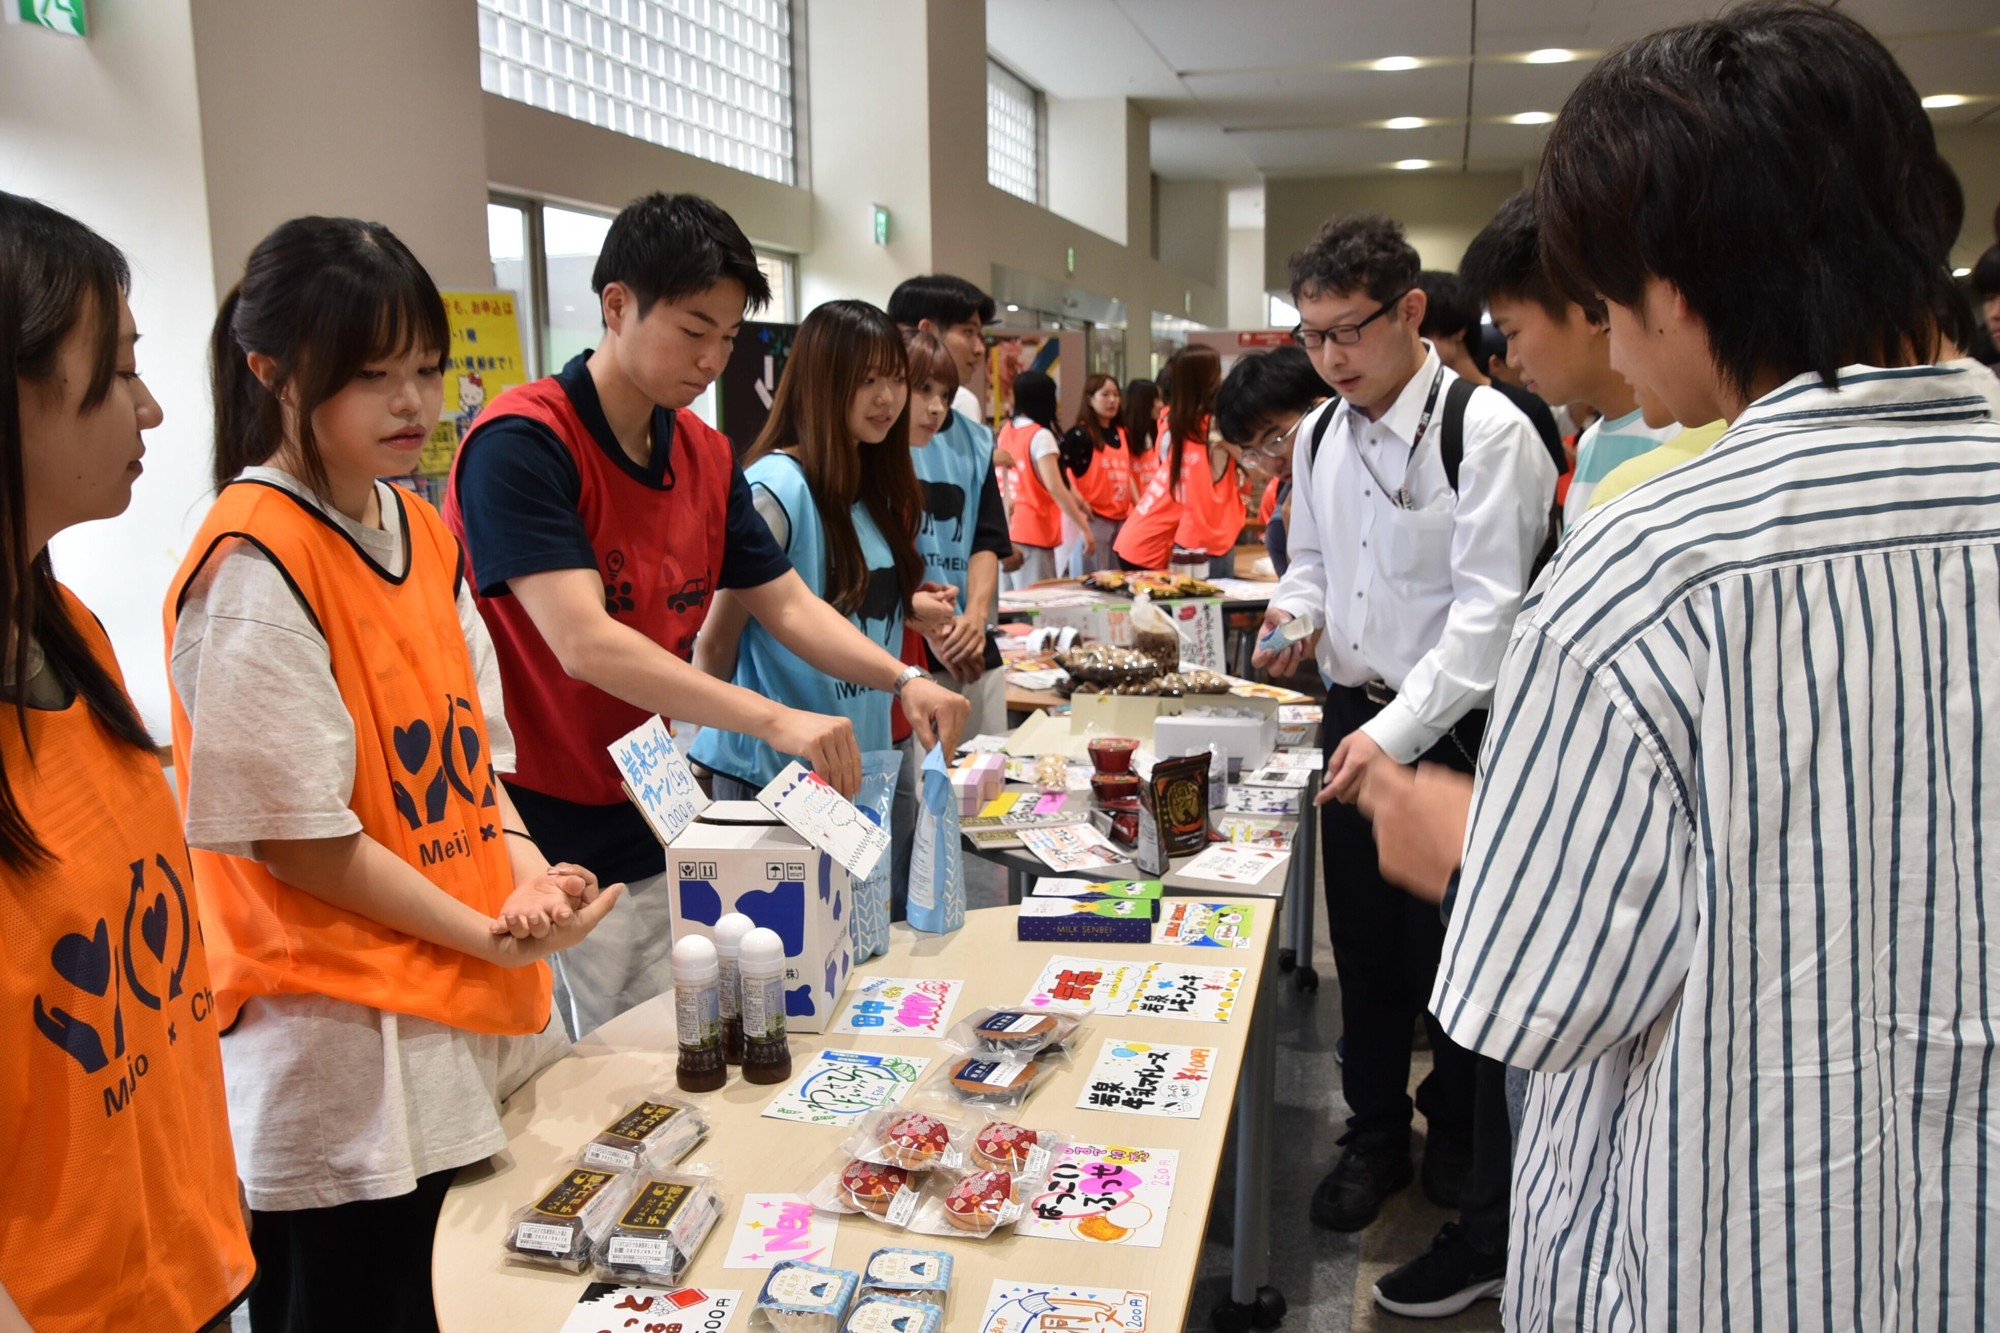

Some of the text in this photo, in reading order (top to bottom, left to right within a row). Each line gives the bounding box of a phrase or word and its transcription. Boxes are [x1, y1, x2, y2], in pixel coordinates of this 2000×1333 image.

[419, 828, 471, 868] Meij
[1056, 925, 1113, 935] MILK SENBEI
[1047, 969, 1104, 1002] 完売
[1167, 974, 1204, 1013] レモンケーキ
[1139, 993, 1171, 1014] 岩泉
[1088, 1081, 1126, 1108] 岩泉
[646, 1184, 685, 1226] チョコ大福
[1125, 1298, 1143, 1329] 200円
